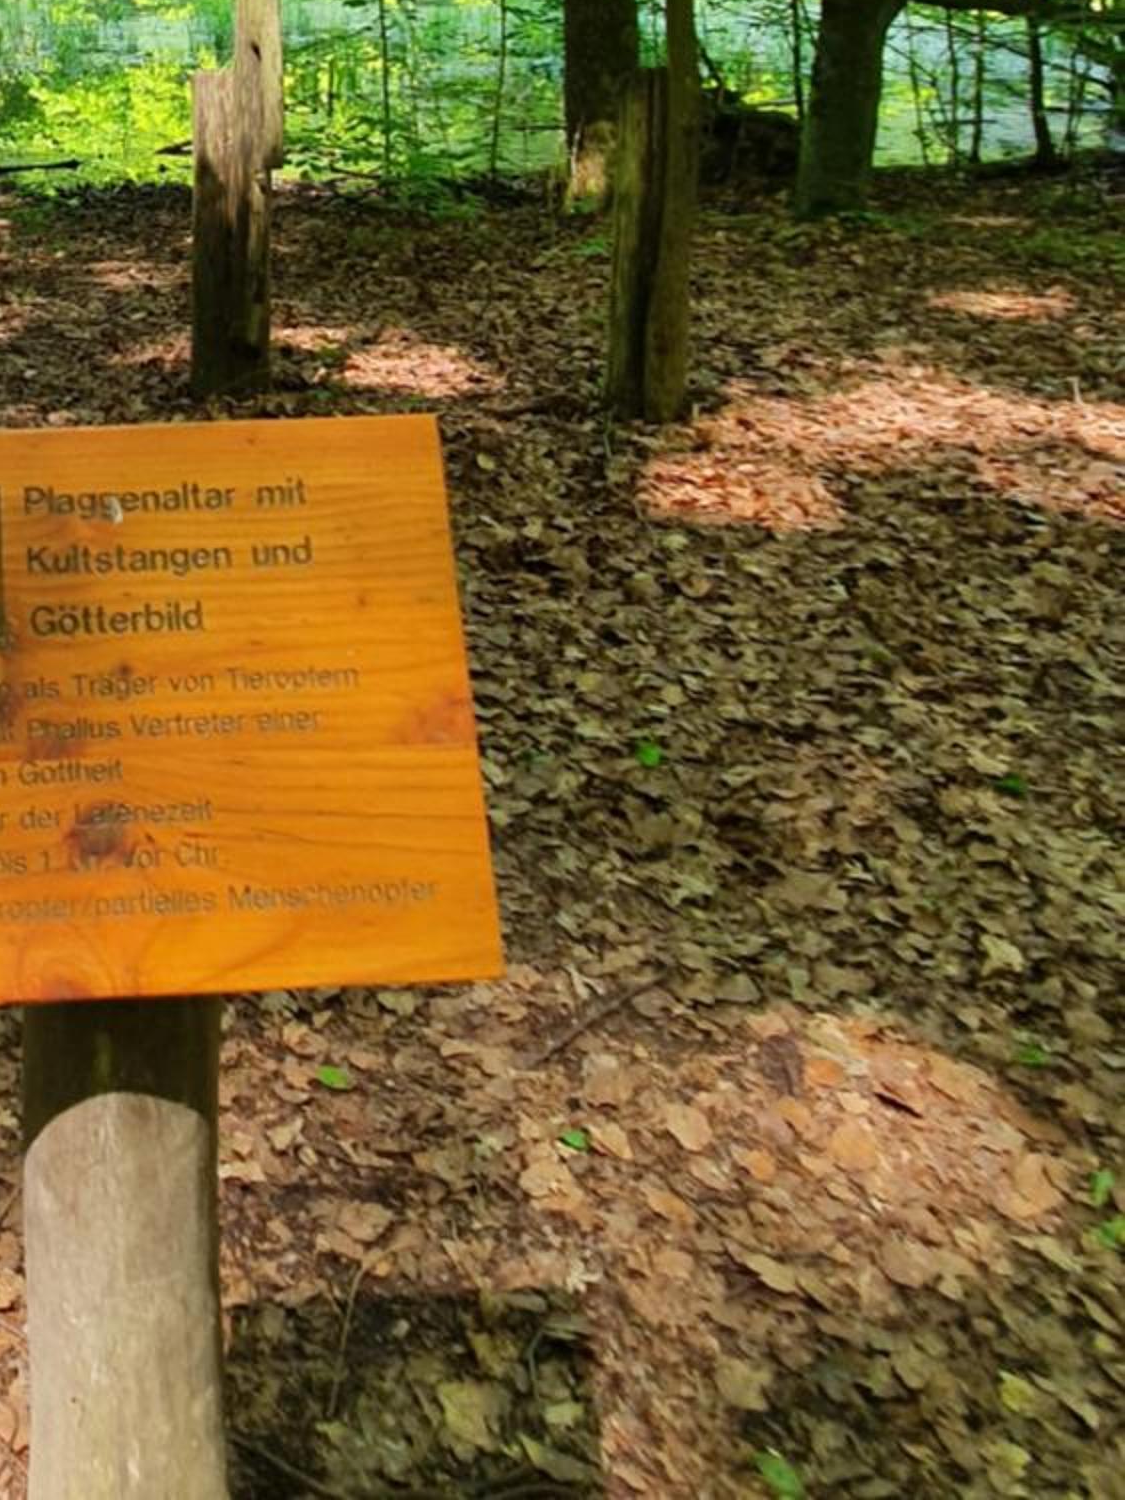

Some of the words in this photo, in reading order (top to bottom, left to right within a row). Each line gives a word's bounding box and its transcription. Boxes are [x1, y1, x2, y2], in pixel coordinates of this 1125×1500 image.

[255, 477, 307, 506] mit
[26, 543, 233, 576] Kultstangen
[252, 535, 312, 566] und
[30, 600, 205, 636] Götterbild
[27, 676, 59, 699] als
[168, 672, 214, 693] von
[128, 710, 244, 738] Vertreter
[254, 706, 322, 732] einer
[18, 758, 123, 786] Gottheit
[20, 803, 59, 830] der
